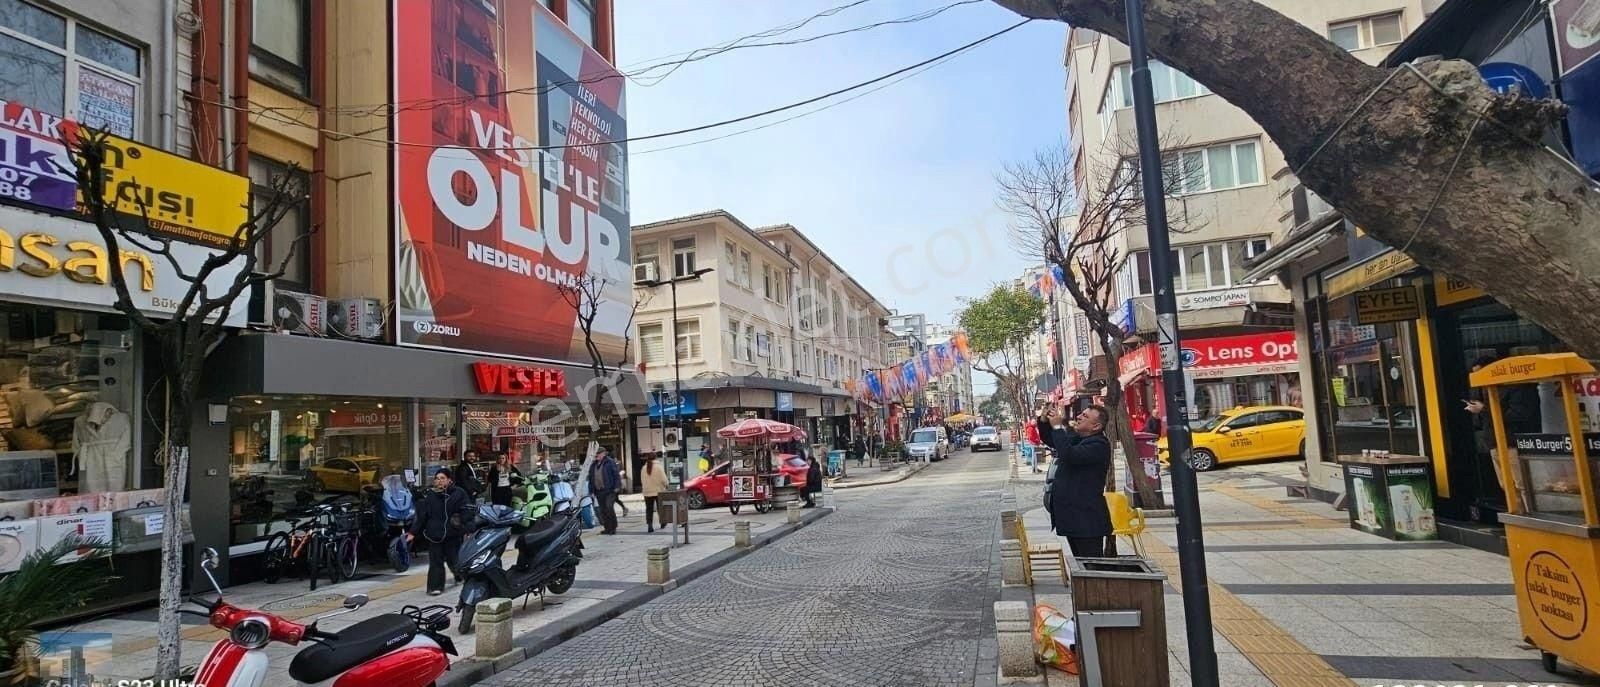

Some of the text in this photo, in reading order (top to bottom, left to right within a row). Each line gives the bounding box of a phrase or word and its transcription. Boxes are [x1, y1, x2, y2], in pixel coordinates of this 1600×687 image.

[577, 86, 597, 108] İLERİ
[574, 101, 612, 136] TEKNOLOJİ
[571, 118, 601, 143] HER EVE
[470, 109, 599, 206] VESTEL'LE
[427, 144, 620, 276] OLUR
[468, 241, 531, 277] NEDEN
[1193, 295, 1222, 304] SOMPO
[1223, 292, 1247, 302] JAPAN
[1359, 292, 1415, 309] EYFEL
[432, 324, 460, 337] ZORLU
[1208, 346, 1255, 361] Lens
[472, 360, 568, 397] VESTEL
[1510, 361, 1537, 377] burger
[1517, 439, 1535, 449] Islak
[1535, 439, 1563, 451] Burger
[56, 518, 84, 526] dinar
[1533, 564, 1569, 584] Taksim
[1550, 584, 1580, 606] burger
[1541, 602, 1574, 623] noktası
